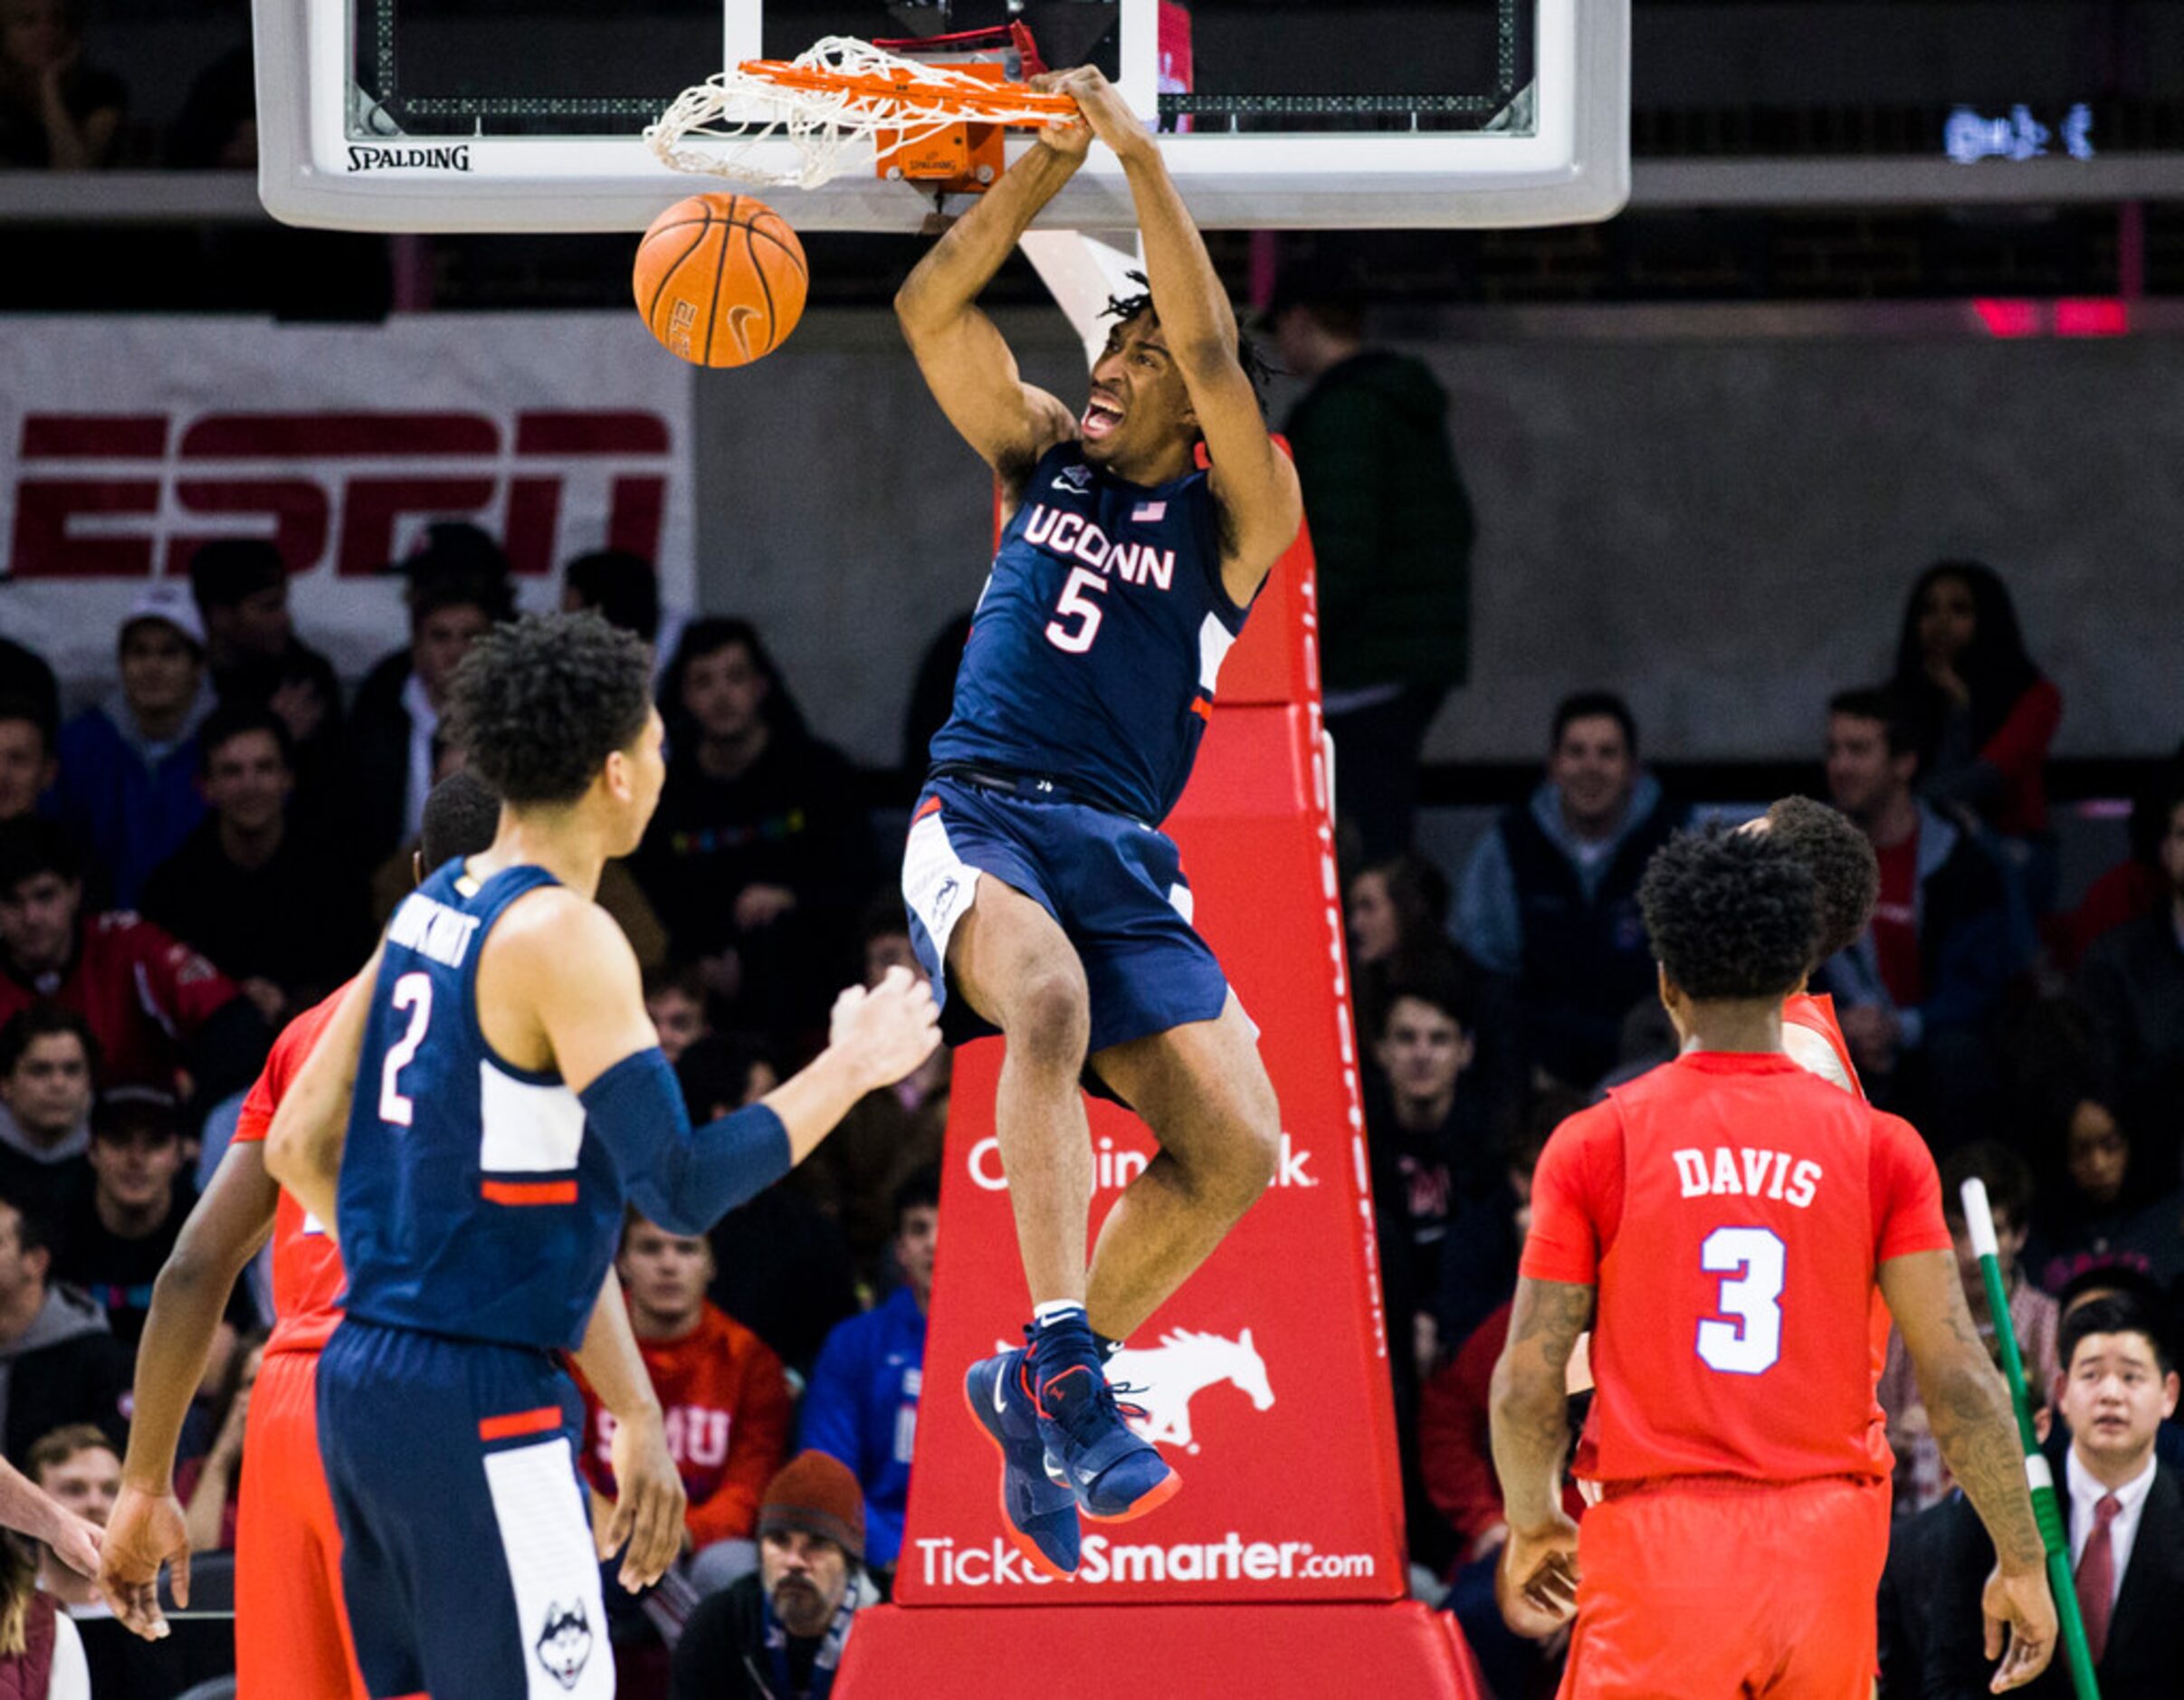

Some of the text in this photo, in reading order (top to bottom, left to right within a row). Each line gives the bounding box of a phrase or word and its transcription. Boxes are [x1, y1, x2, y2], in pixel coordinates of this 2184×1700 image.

[347, 145, 473, 172] SPALDING
[9, 410, 672, 578] ESPN
[1023, 503, 1176, 591] UCONN
[1044, 566, 1109, 654] 5
[378, 971, 434, 1126] 2
[1672, 1146, 1823, 1208] DAVIS
[1694, 1225, 1788, 1376] 3
